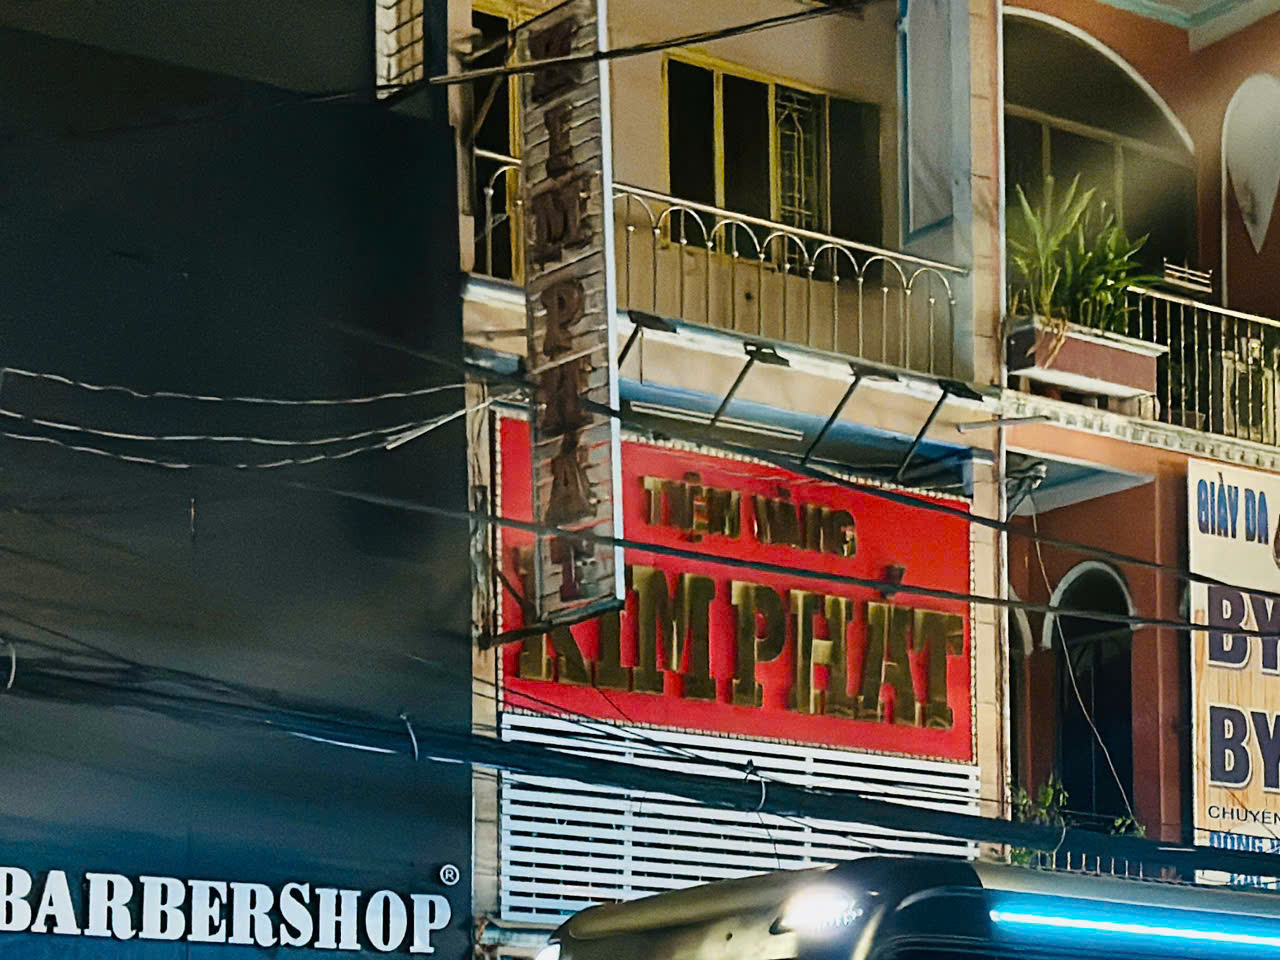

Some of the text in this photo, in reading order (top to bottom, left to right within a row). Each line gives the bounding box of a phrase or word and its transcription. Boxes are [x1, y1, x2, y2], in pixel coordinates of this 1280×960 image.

[1197, 472, 1269, 545] GIÀY DA
[0, 866, 452, 954] BARBERSHOP
